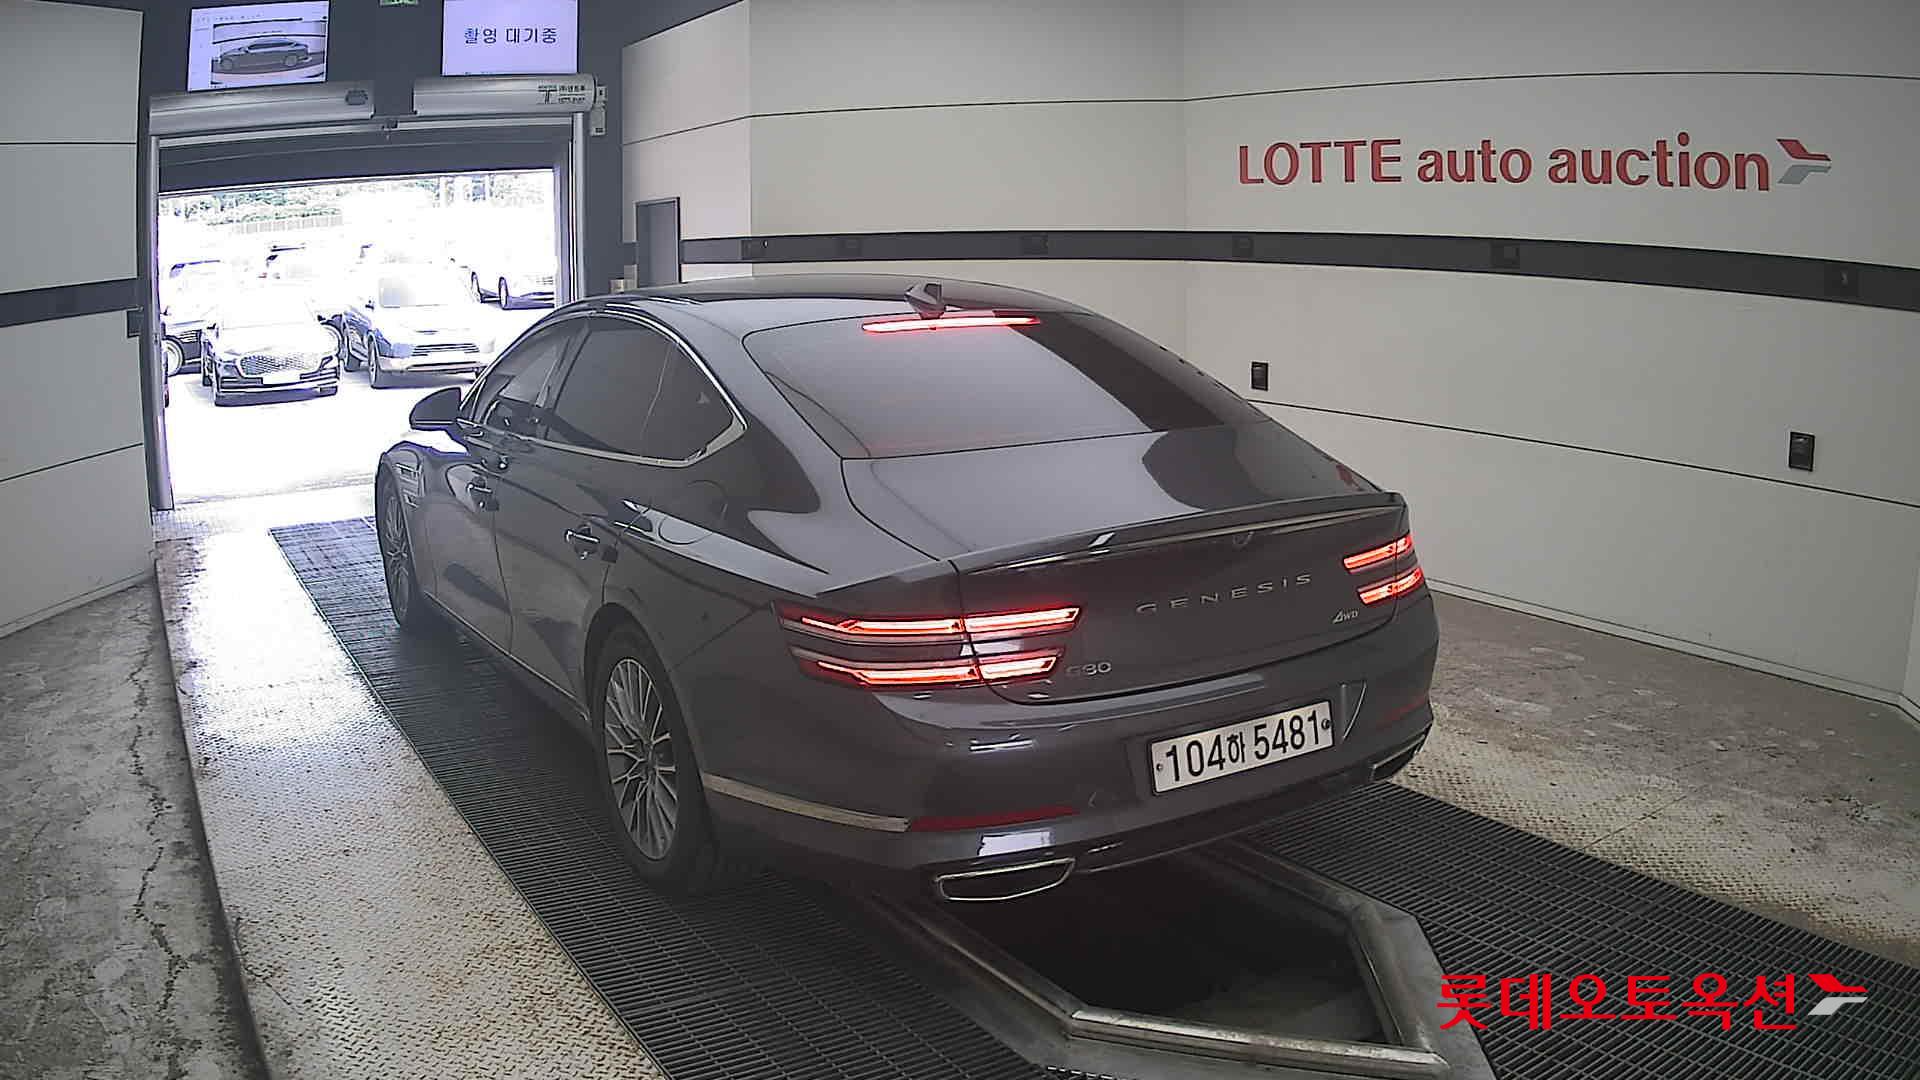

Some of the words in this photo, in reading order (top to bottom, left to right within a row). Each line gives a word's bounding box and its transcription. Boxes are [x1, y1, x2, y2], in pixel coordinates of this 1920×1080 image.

[1238, 138, 1401, 185] LOTTE
[1417, 139, 1532, 184] auto
[1548, 131, 1770, 191] auction
[1136, 573, 1311, 615] GENESIS
[1254, 710, 1319, 760] 5481
